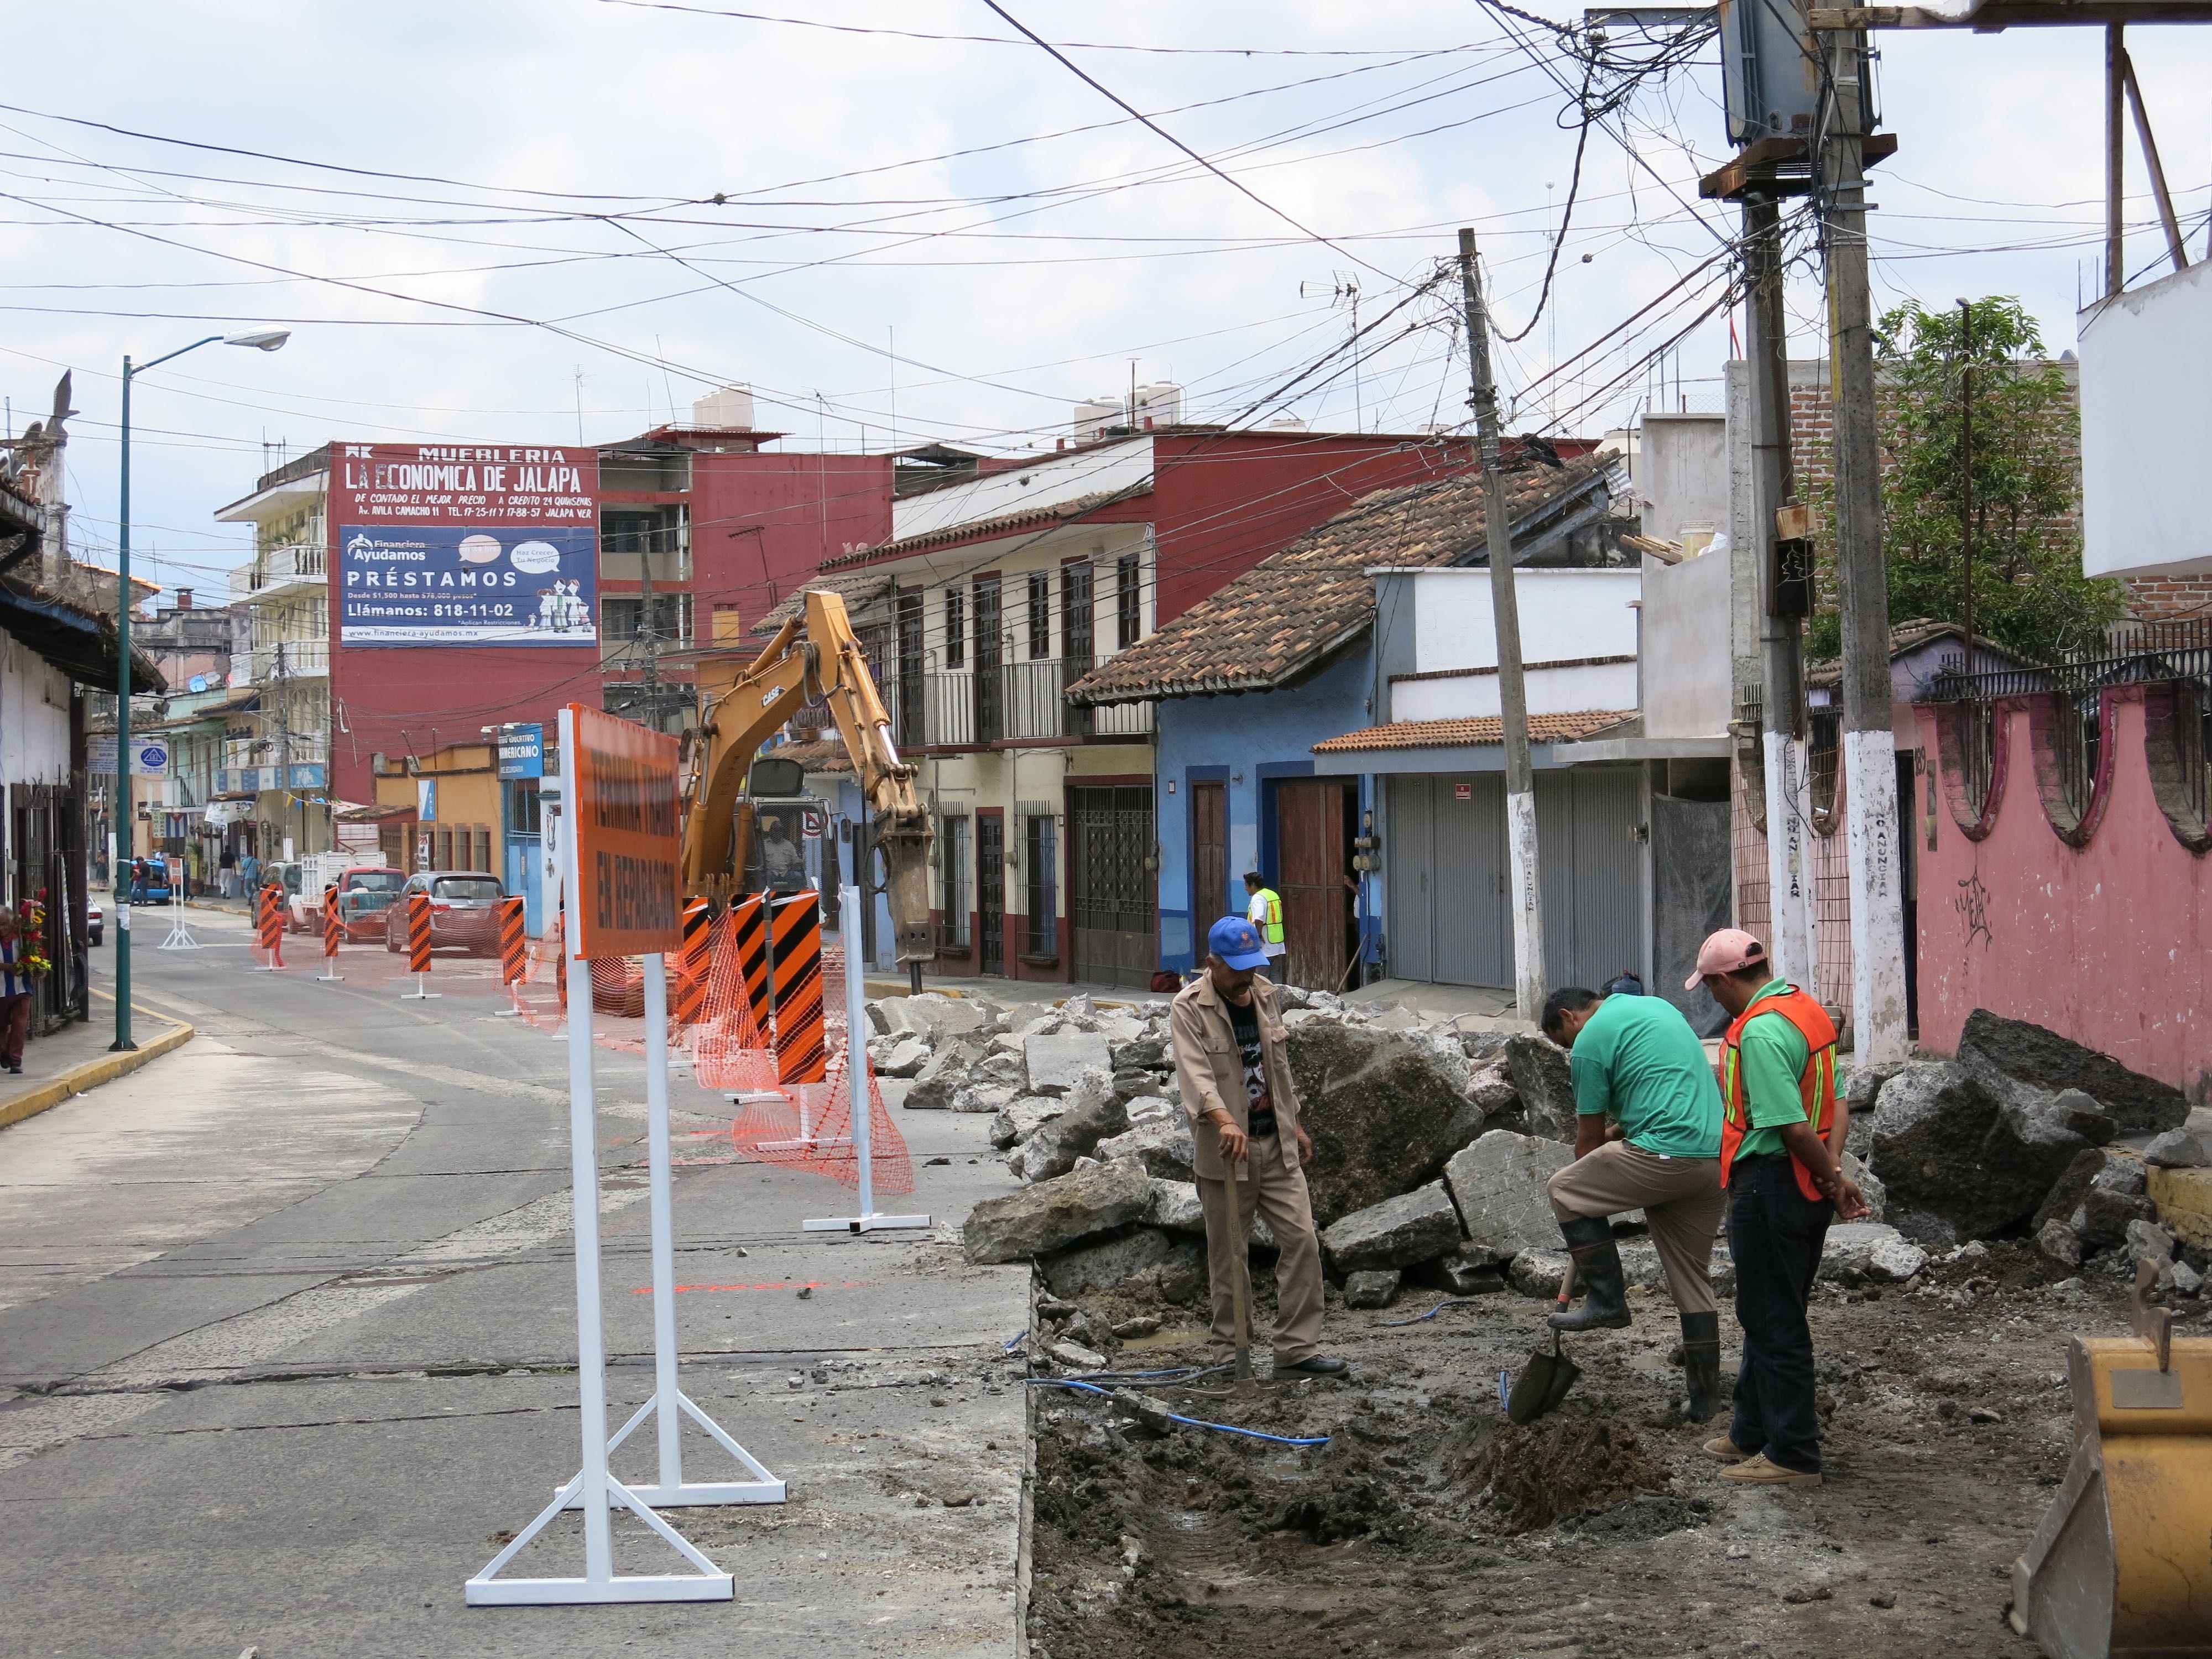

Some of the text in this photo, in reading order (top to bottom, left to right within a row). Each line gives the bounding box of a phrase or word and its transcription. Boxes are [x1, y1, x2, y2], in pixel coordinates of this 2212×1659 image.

[419, 447, 566, 463] MUEBLERIA
[346, 463, 581, 493] LA ECONOMICA DE JALAPA
[354, 493, 592, 507] DE CONTADO EL MEJOR PRECIO A CREDITO 24 QUINSENAS
[372, 505, 393, 515] AVILA
[395, 506, 430, 516] CAMACHO
[432, 507, 440, 517] 11
[498, 508, 504, 517] Y
[507, 508, 541, 518] 17-88-57
[545, 508, 575, 518] JALAPA
[577, 508, 592, 519] VER
[374, 540, 426, 549] Financiera
[353, 549, 426, 563] Ayudamos
[347, 566, 517, 587] PRÉSTAMOS
[347, 603, 514, 617] Llámanos: 818-11-02
[348, 629, 478, 639] www.financiera-ayudamos.mx
[763, 685, 780, 707] CASE
[597, 850, 612, 929] EN
[1526, 871, 1535, 911] ANUNCIAR
